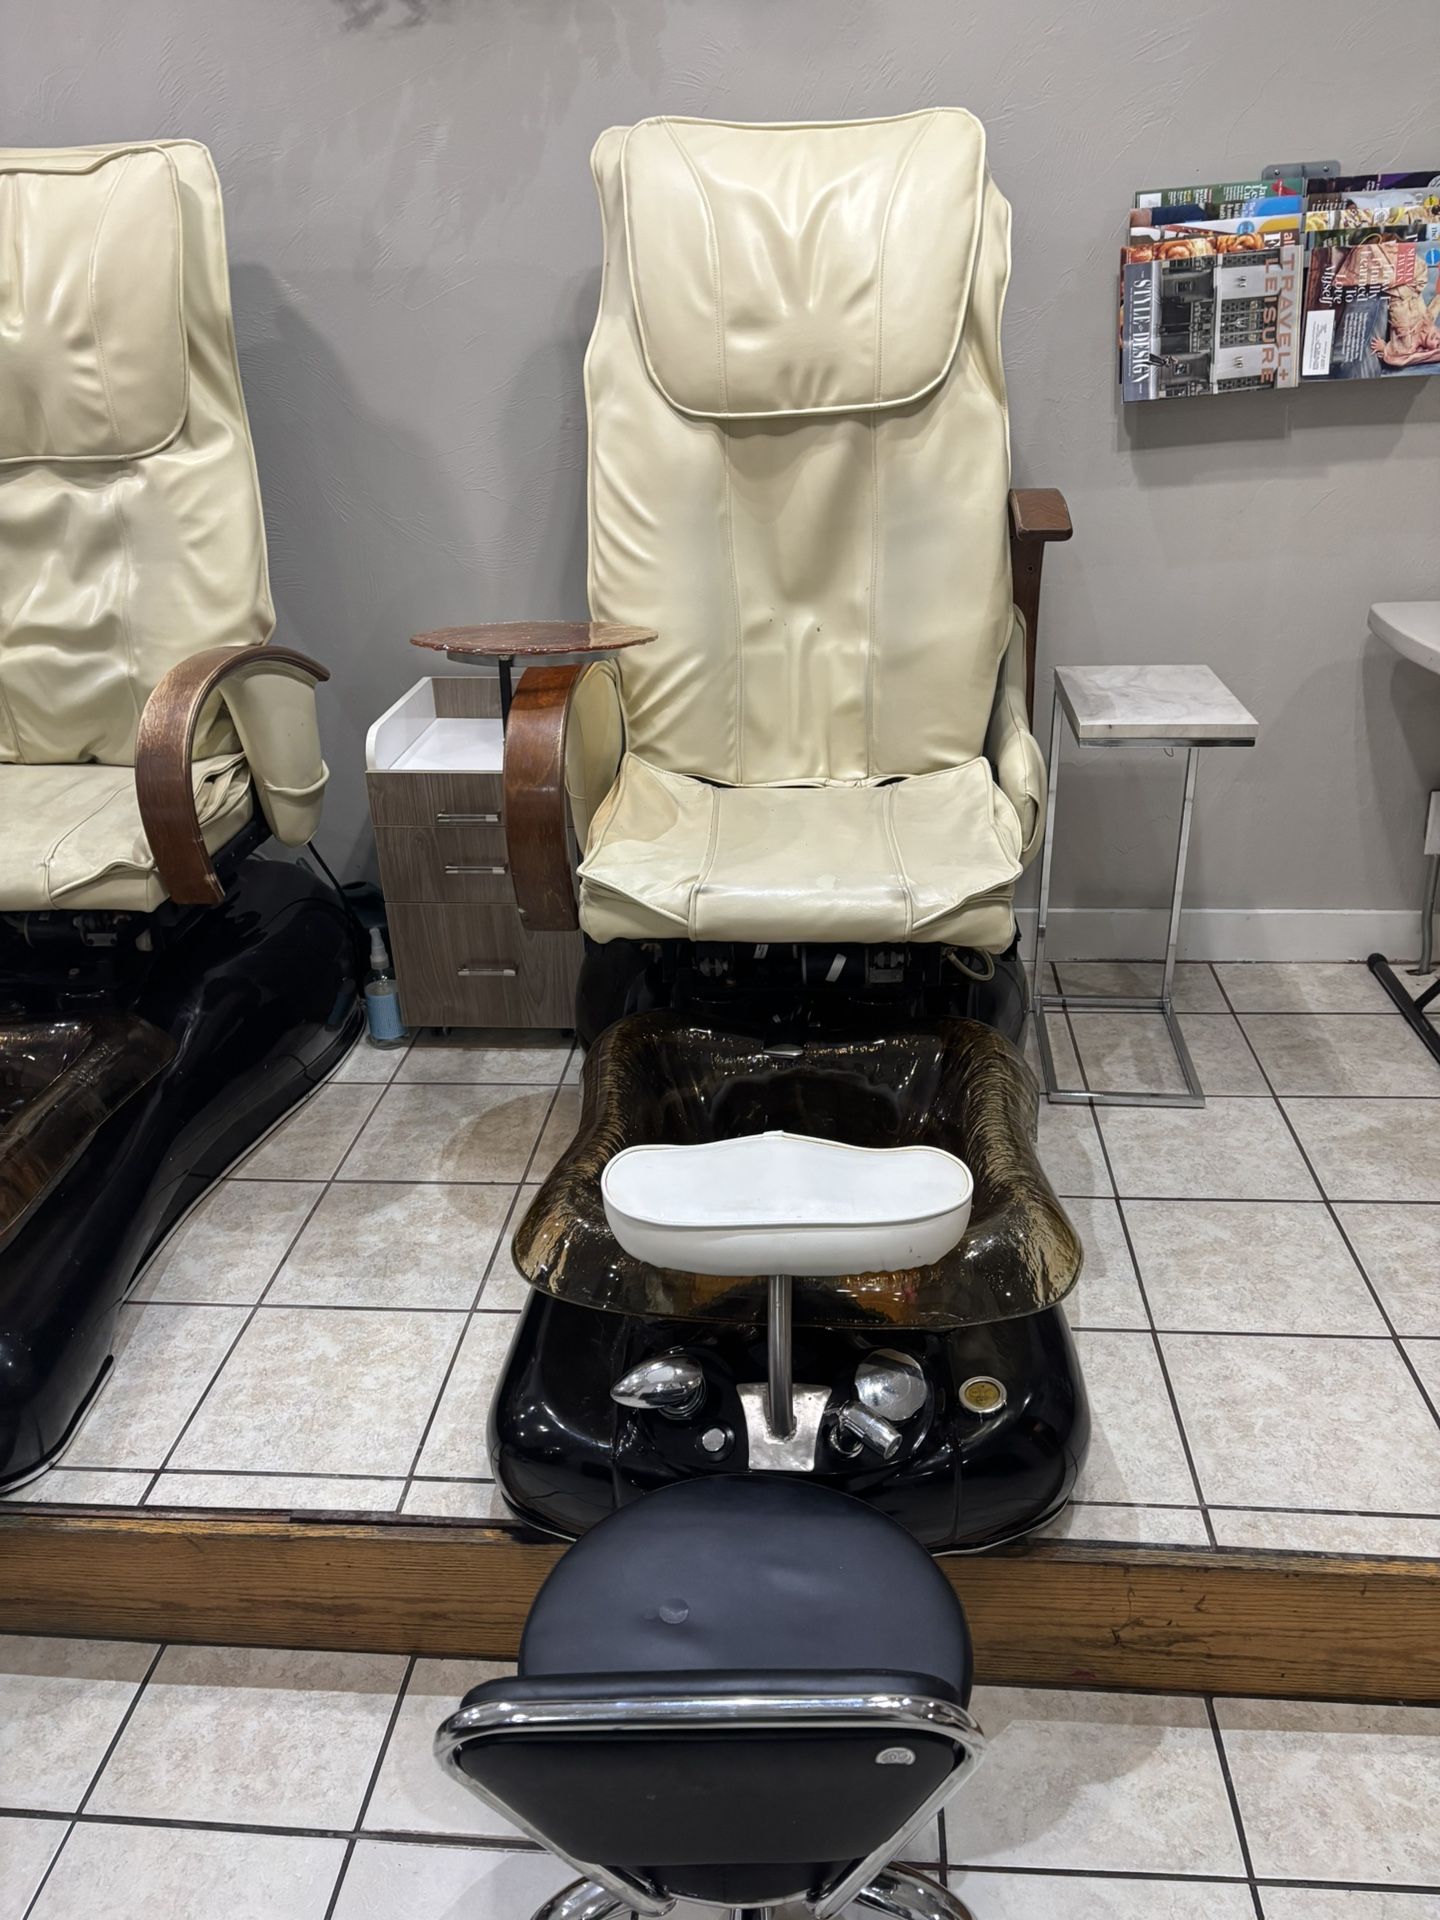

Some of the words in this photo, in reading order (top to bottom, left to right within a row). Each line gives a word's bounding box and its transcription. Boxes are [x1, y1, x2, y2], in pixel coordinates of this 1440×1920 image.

[1356, 250, 1372, 302] Learned
[1367, 257, 1384, 301] Finally
[1397, 253, 1406, 283] TWAIN
[1404, 247, 1415, 283] SHANIA
[1132, 279, 1152, 326] STYLE
[1333, 274, 1346, 304] Love
[1344, 287, 1358, 303] To
[1260, 257, 1279, 384] LEISURE
[1277, 253, 1295, 382] TRAVEL+
[1131, 331, 1151, 384] DESIGN
